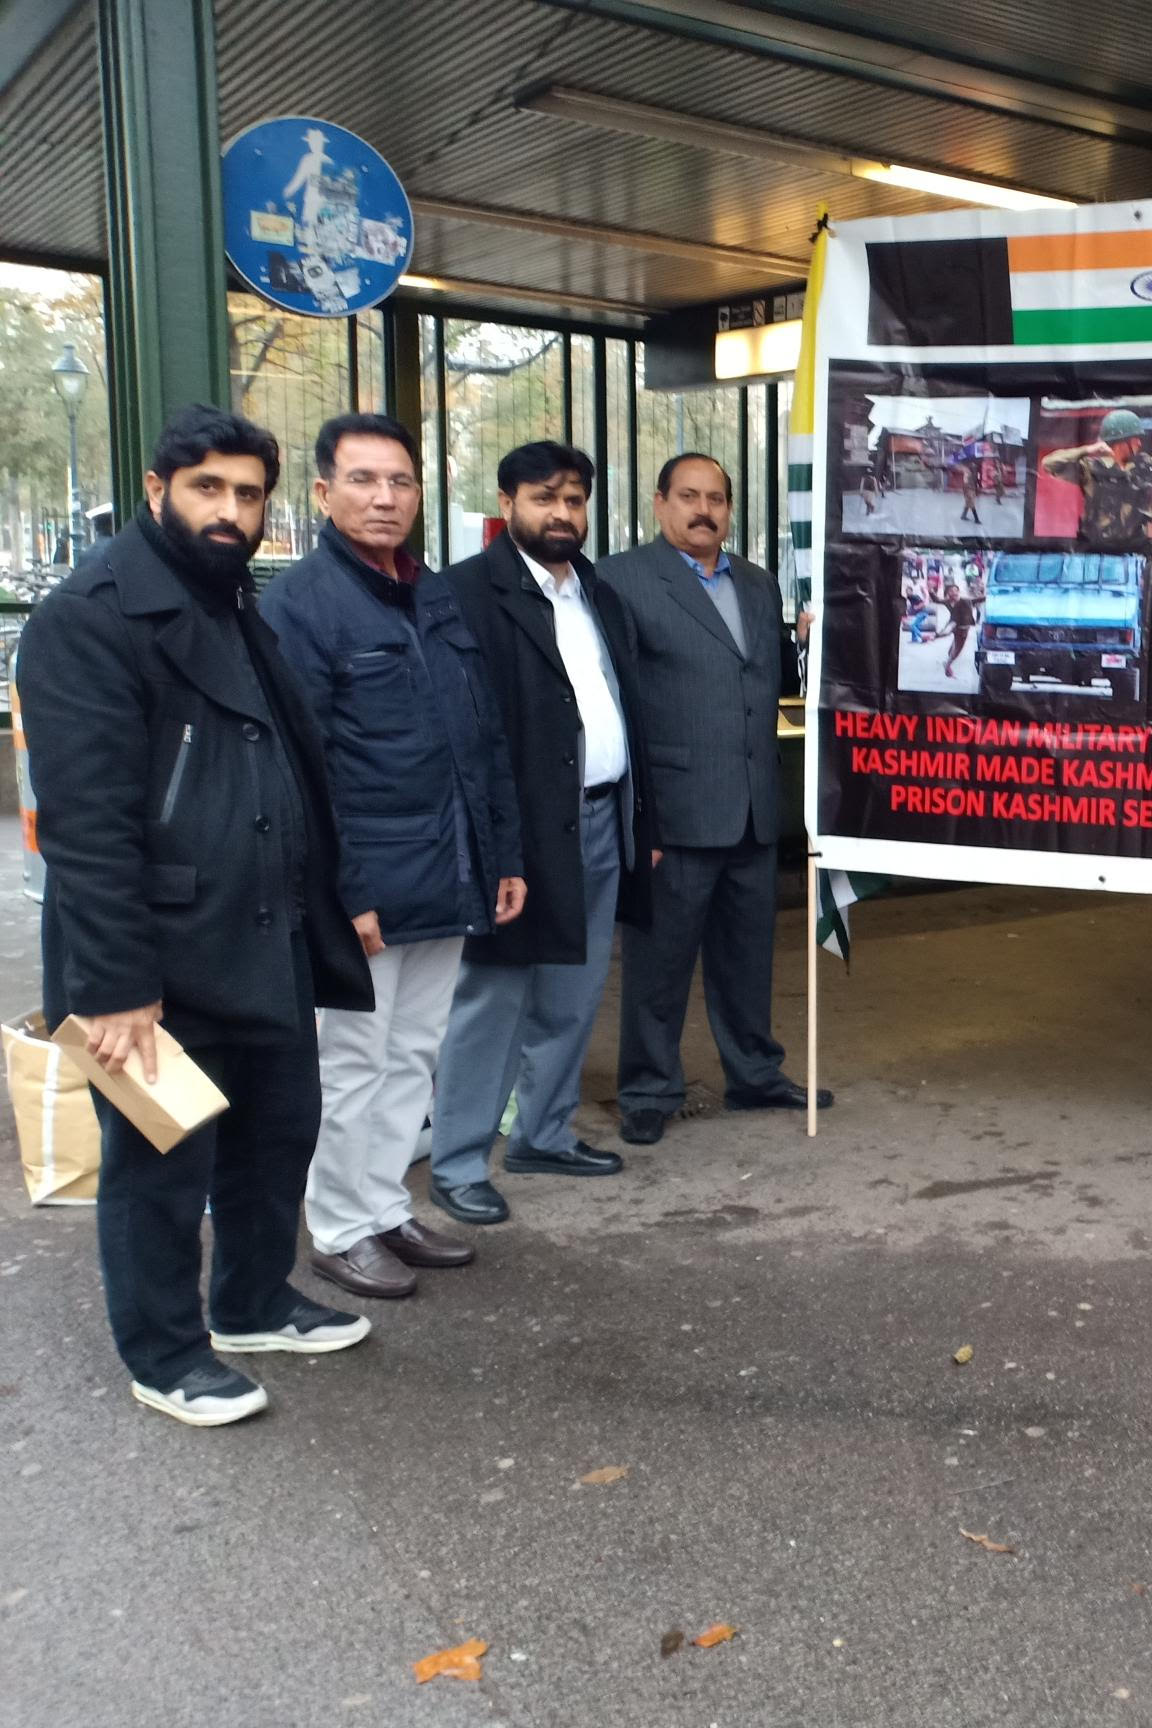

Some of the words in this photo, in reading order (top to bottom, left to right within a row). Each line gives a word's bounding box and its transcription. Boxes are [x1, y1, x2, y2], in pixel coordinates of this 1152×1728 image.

[834, 710, 920, 742] HEAVY
[926, 717, 1022, 748] INDIAN
[1028, 720, 1152, 755] MILITARY
[851, 745, 972, 782] KASHMIR
[976, 753, 1055, 787] MADE
[890, 785, 987, 818] PRISON
[992, 790, 1119, 828] KASHMIR
